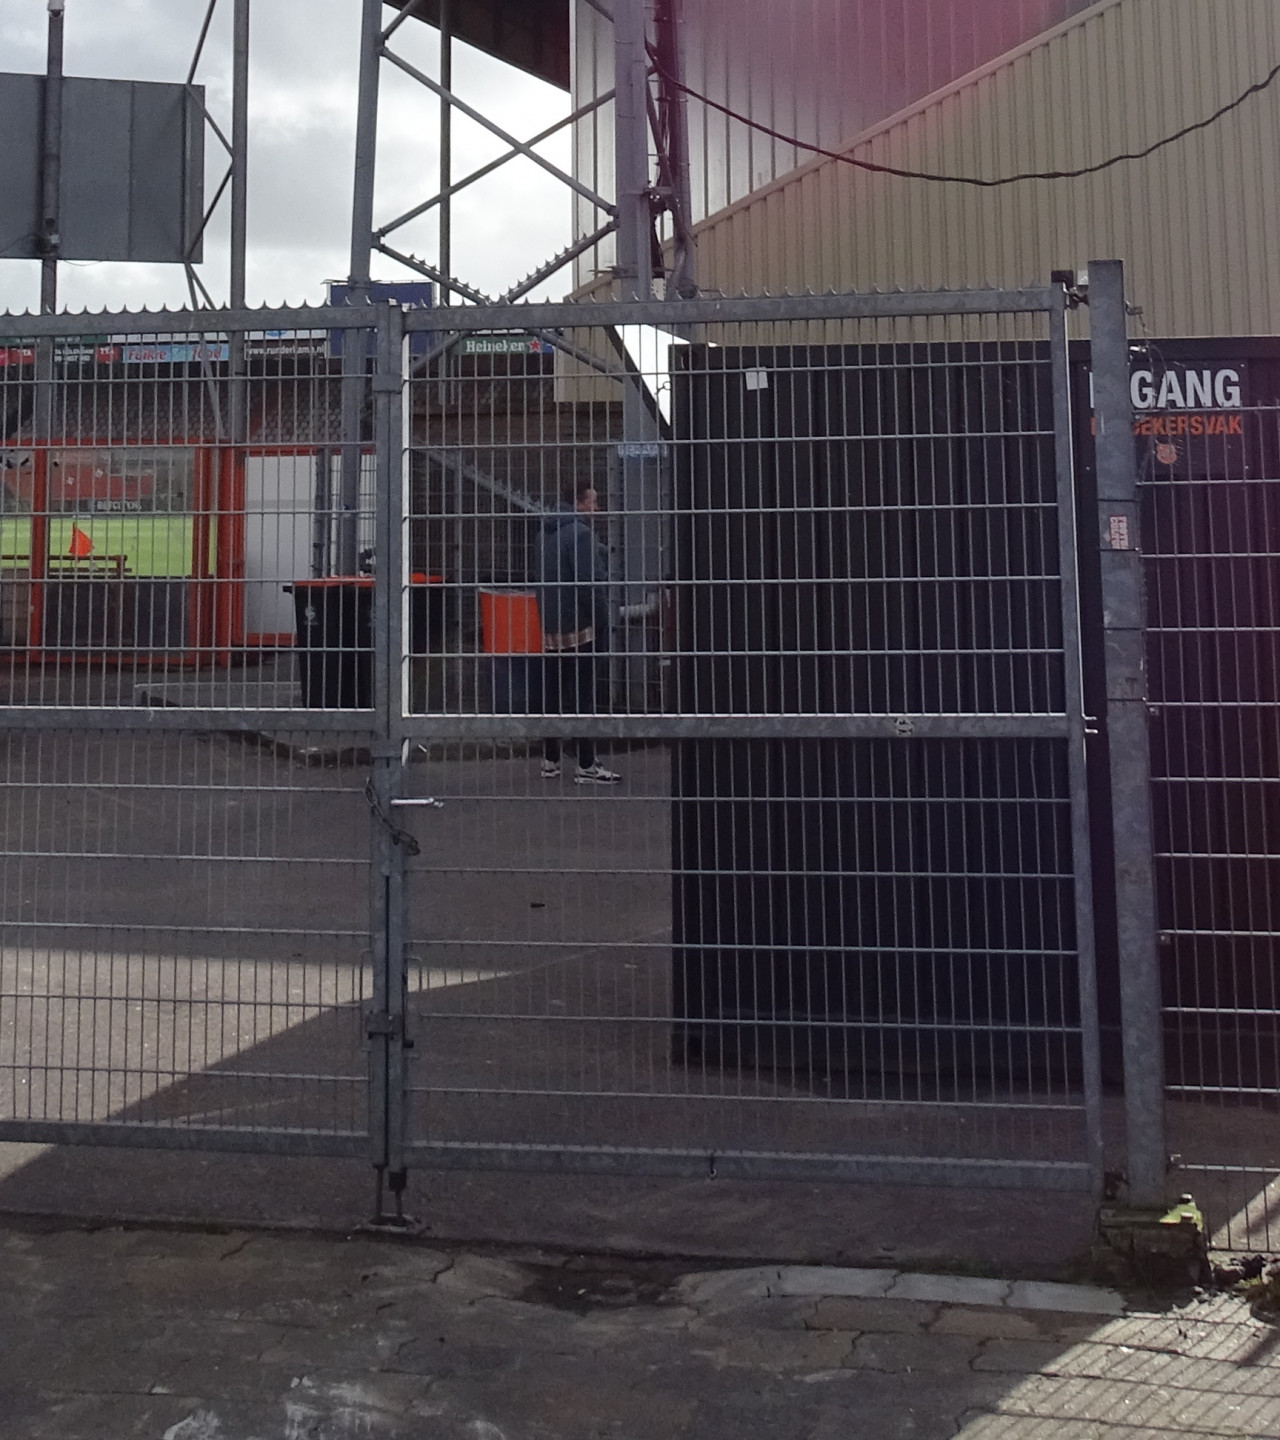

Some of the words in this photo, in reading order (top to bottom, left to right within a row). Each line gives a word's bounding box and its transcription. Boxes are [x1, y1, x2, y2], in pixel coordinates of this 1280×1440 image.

[466, 340, 524, 352] Heineken
[1089, 369, 1240, 409] GANG
[1091, 415, 1242, 435] EKERSVAK
